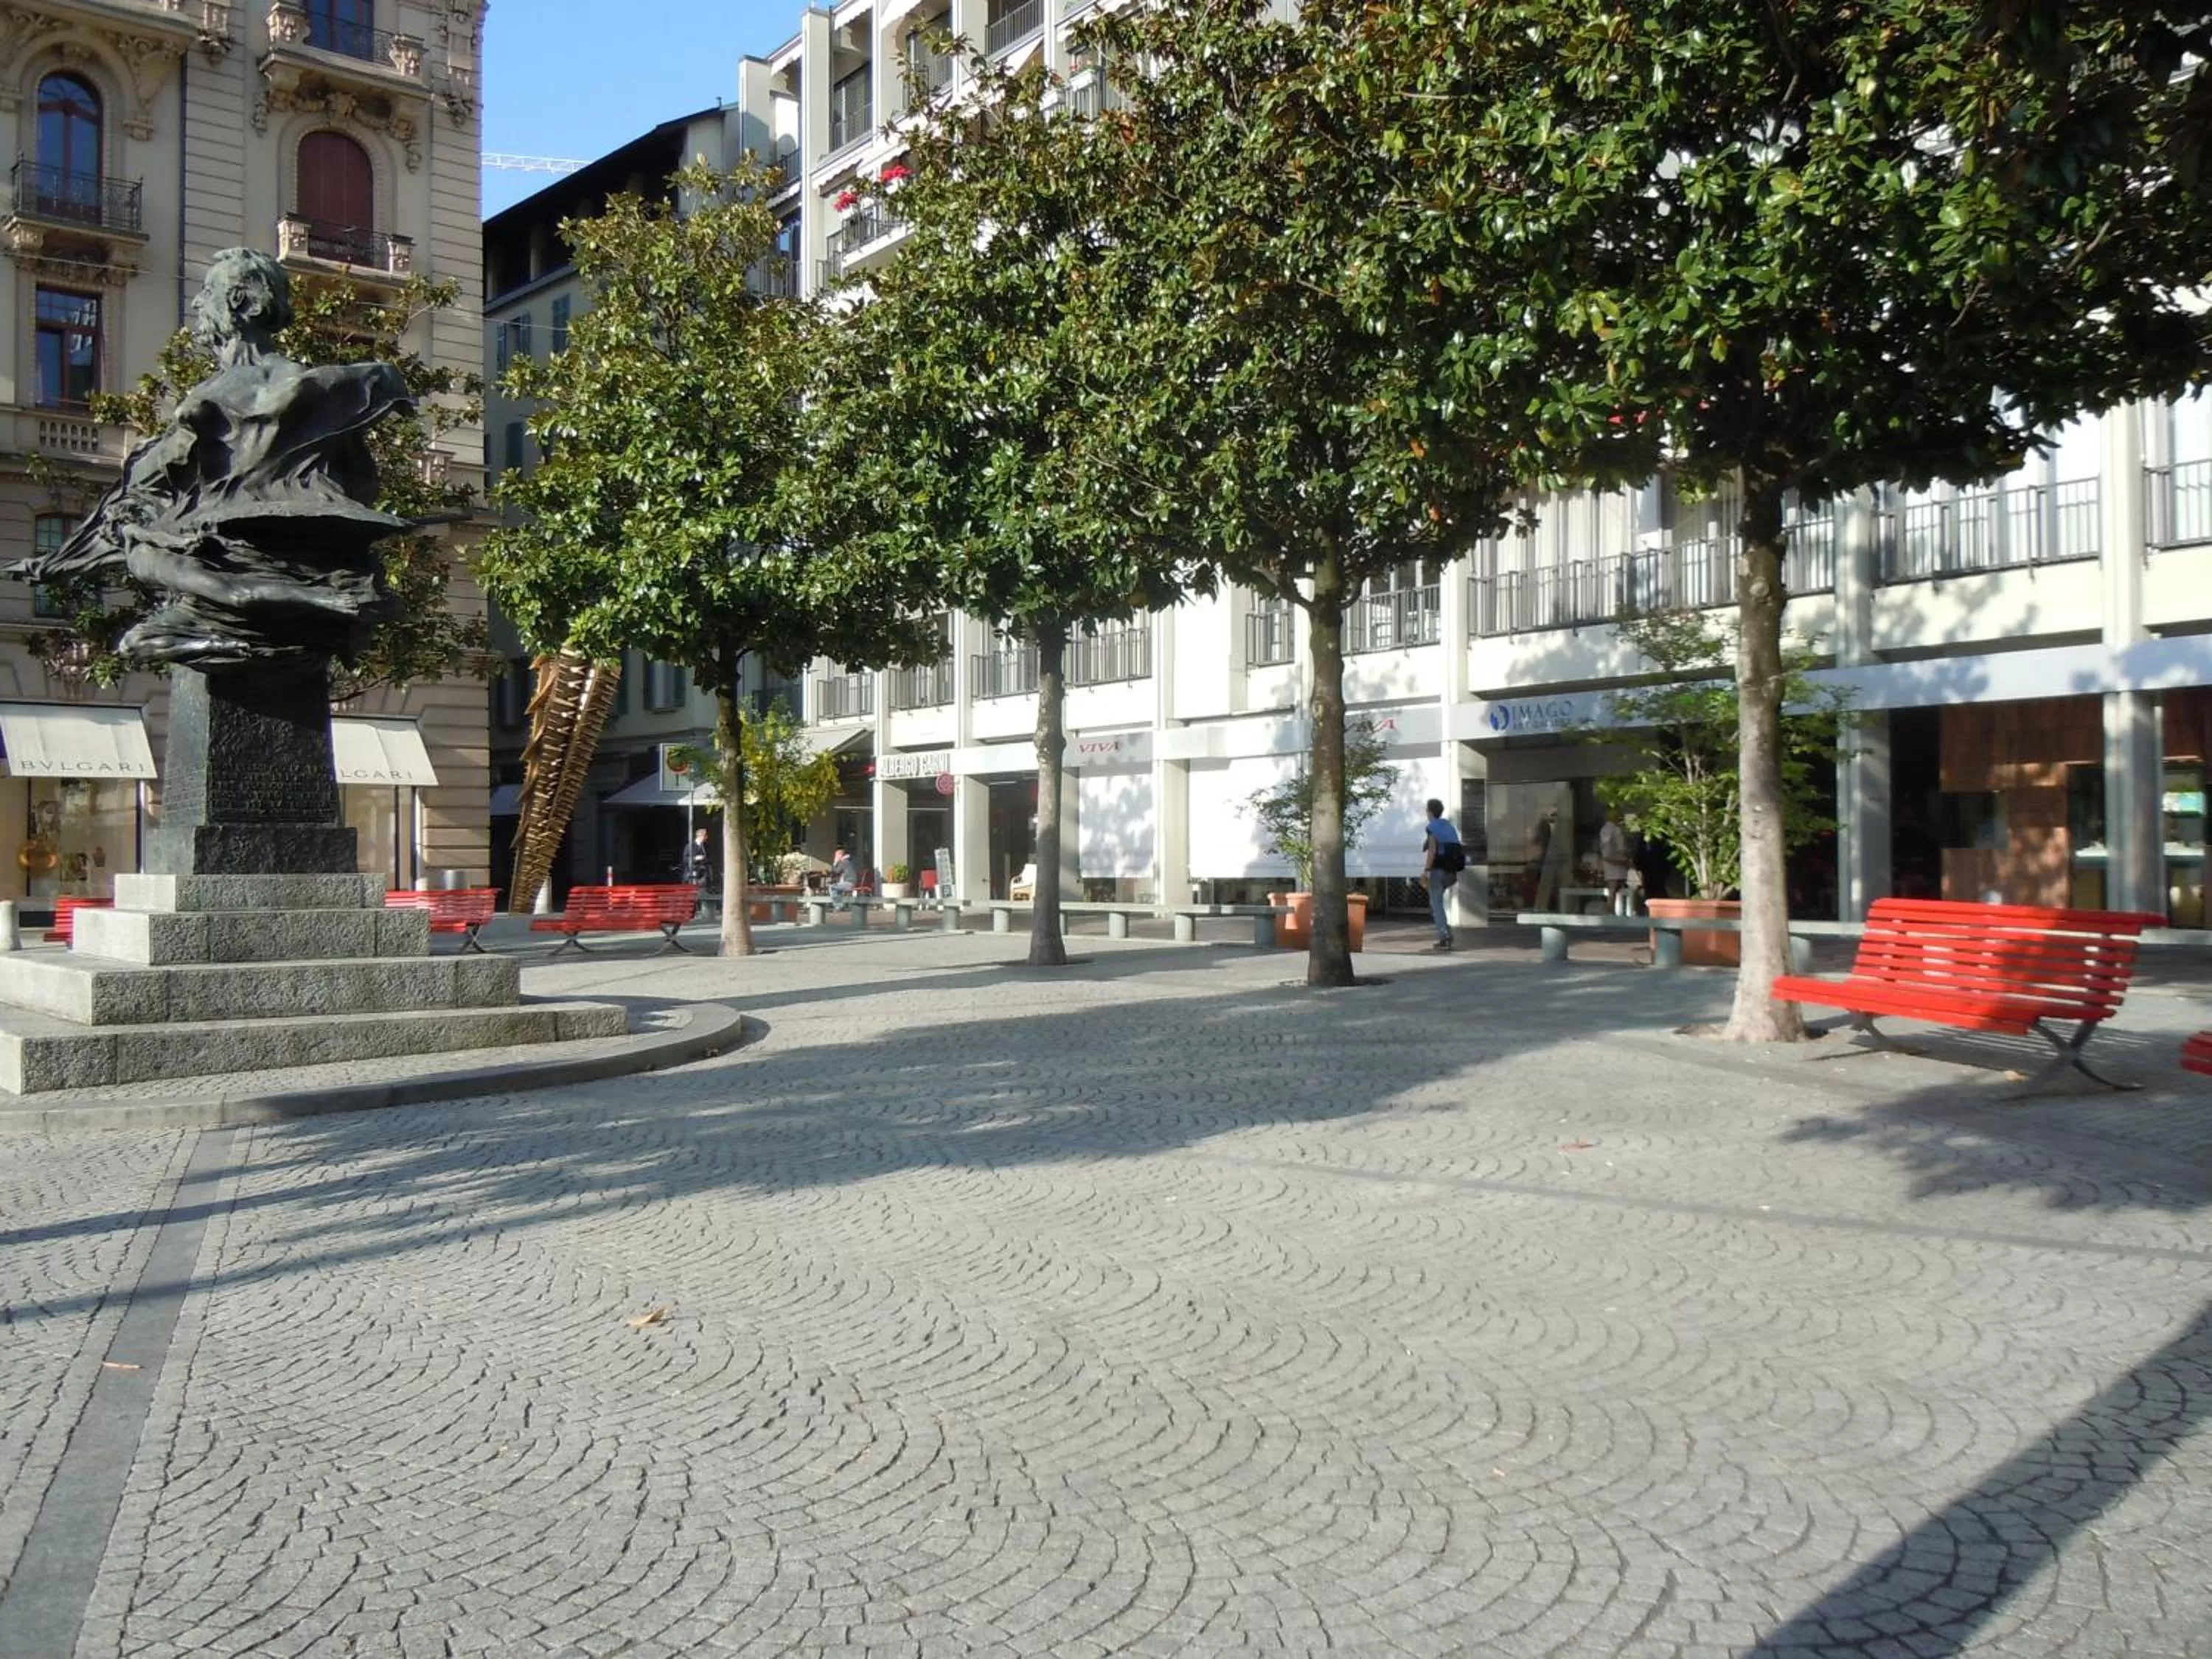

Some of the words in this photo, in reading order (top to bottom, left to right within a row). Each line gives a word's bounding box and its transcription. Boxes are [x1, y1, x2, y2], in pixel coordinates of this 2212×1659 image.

[1512, 700, 1573, 720] IMAGO
[21, 760, 145, 772] BVLGARI
[340, 769, 413, 779] LGARI
[881, 756, 919, 778] ALBERGO
